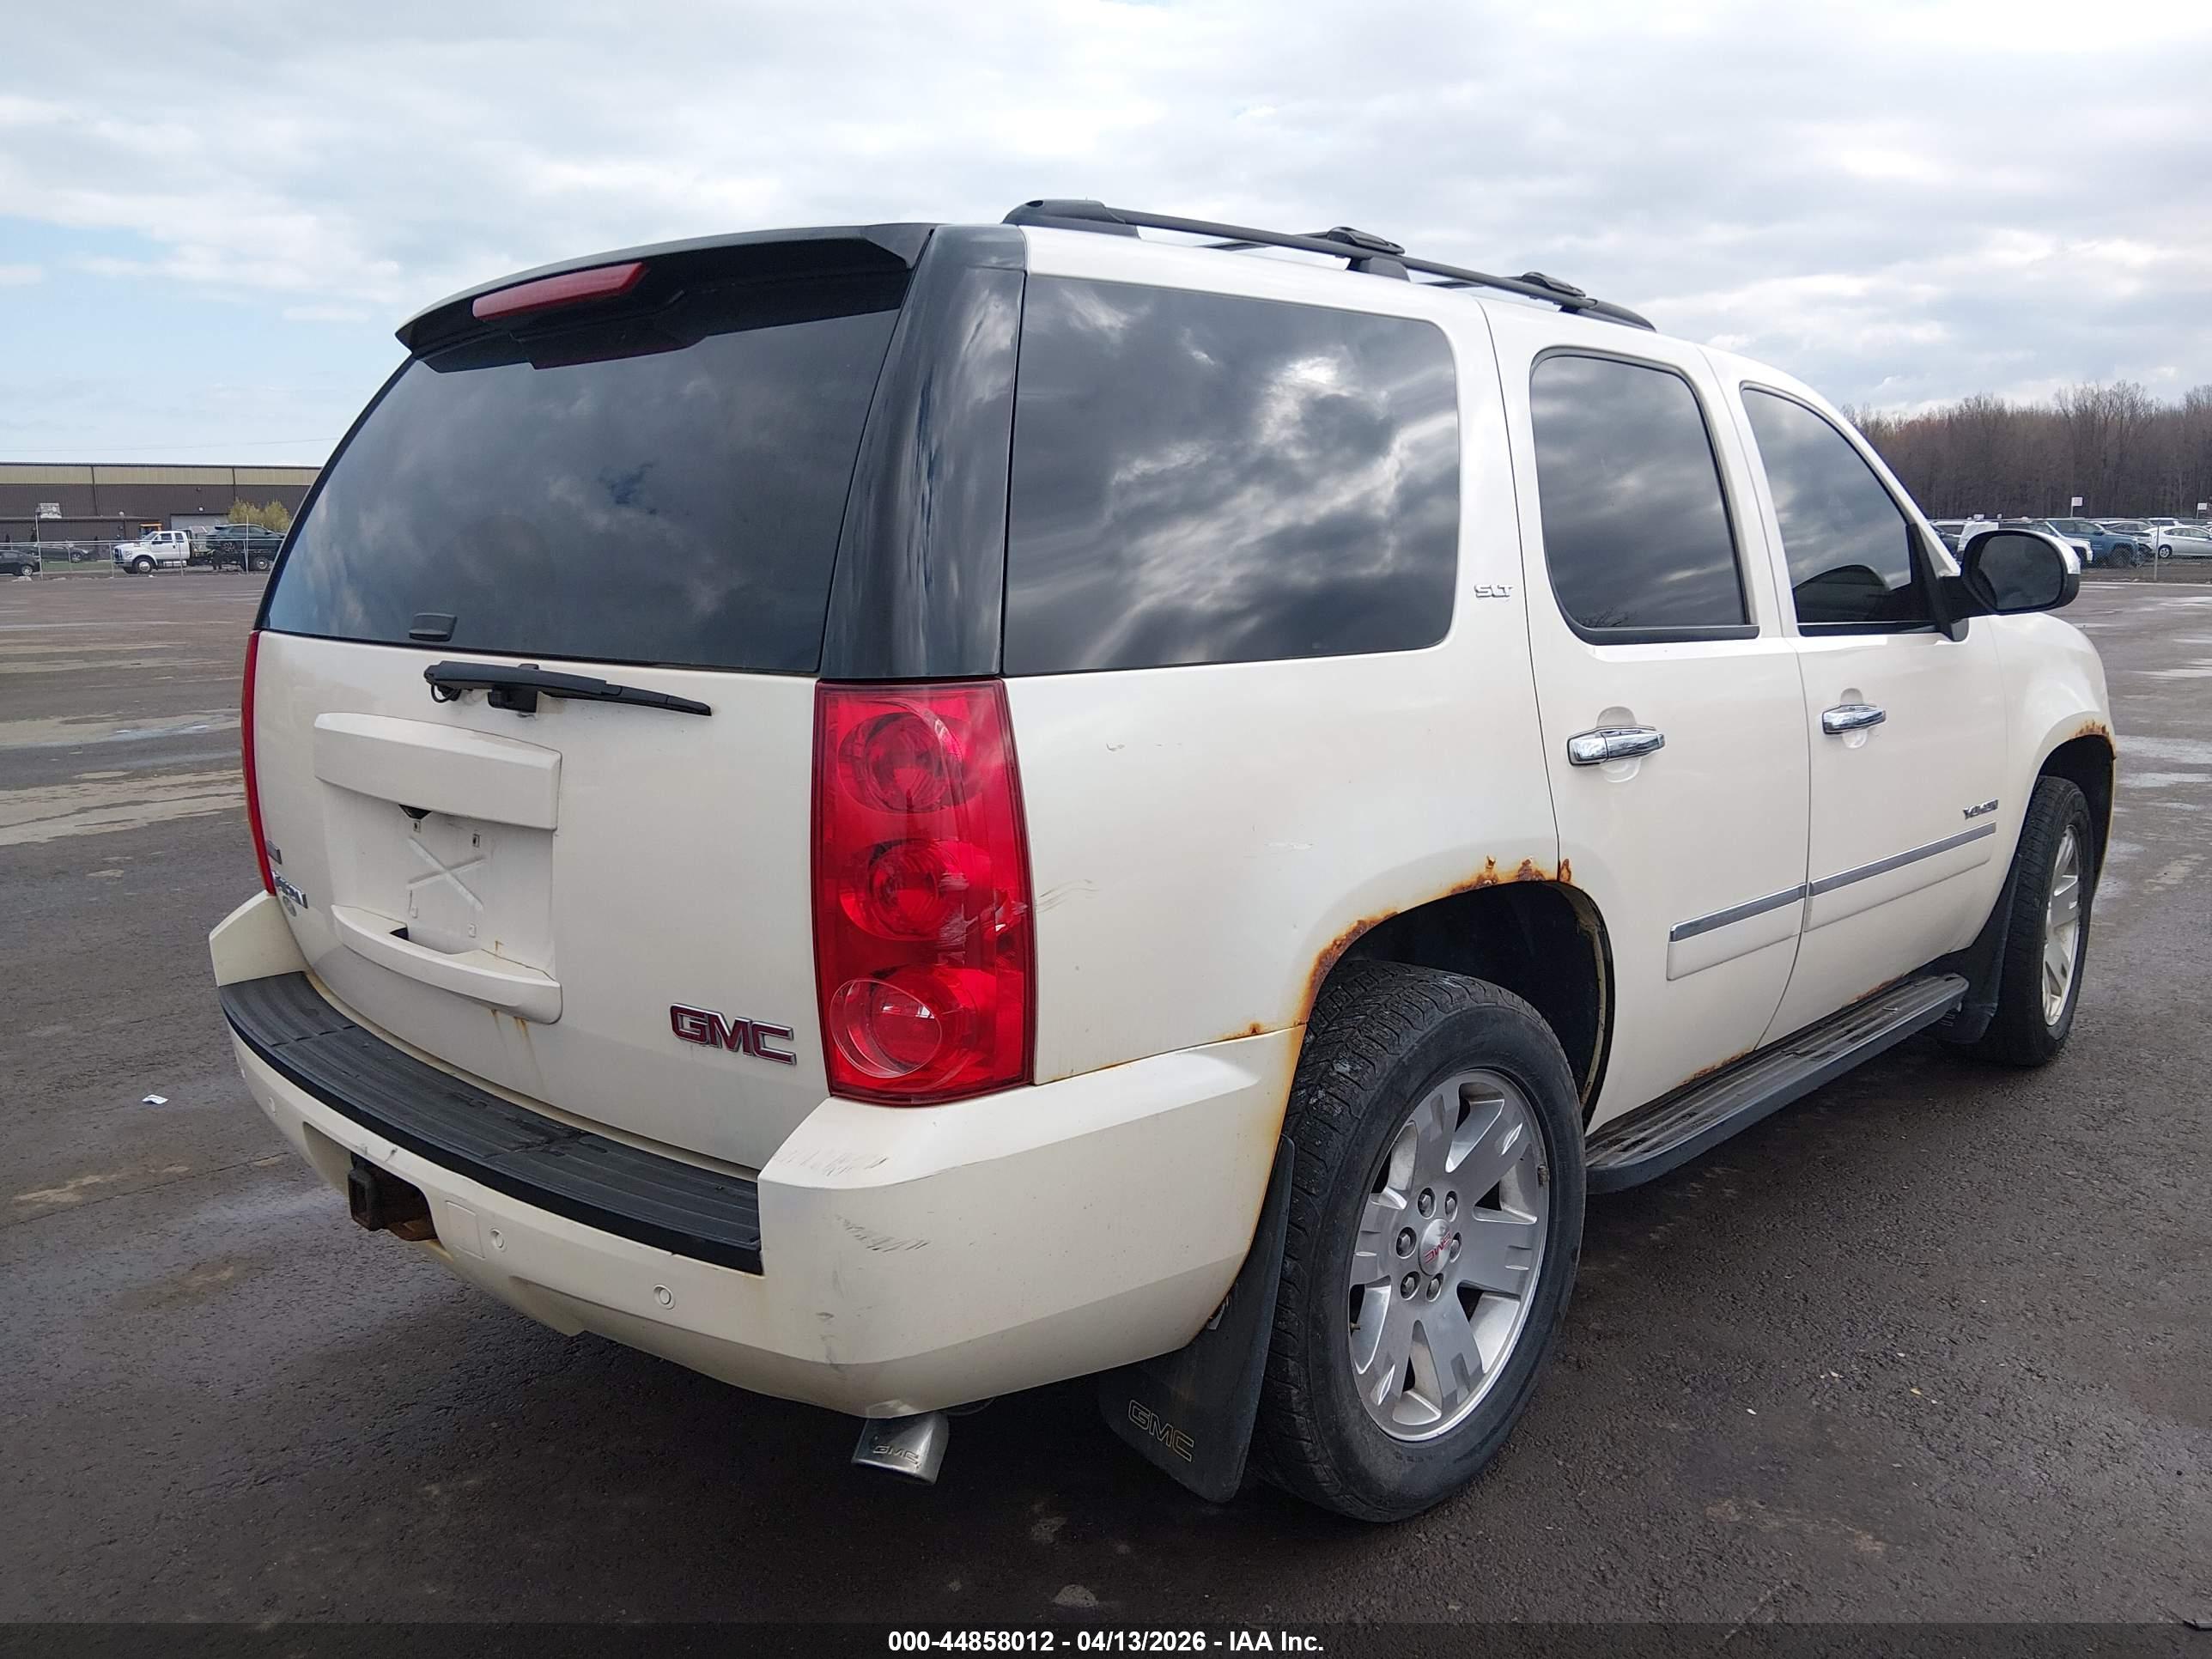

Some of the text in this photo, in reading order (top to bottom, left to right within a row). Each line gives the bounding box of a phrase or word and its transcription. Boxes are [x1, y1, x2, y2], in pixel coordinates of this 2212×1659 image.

[1474, 584, 1513, 598] SLT
[670, 1003, 797, 1065] GMC
[1425, 1230, 1451, 1264] GMC
[1128, 1400, 1194, 1462] GMC
